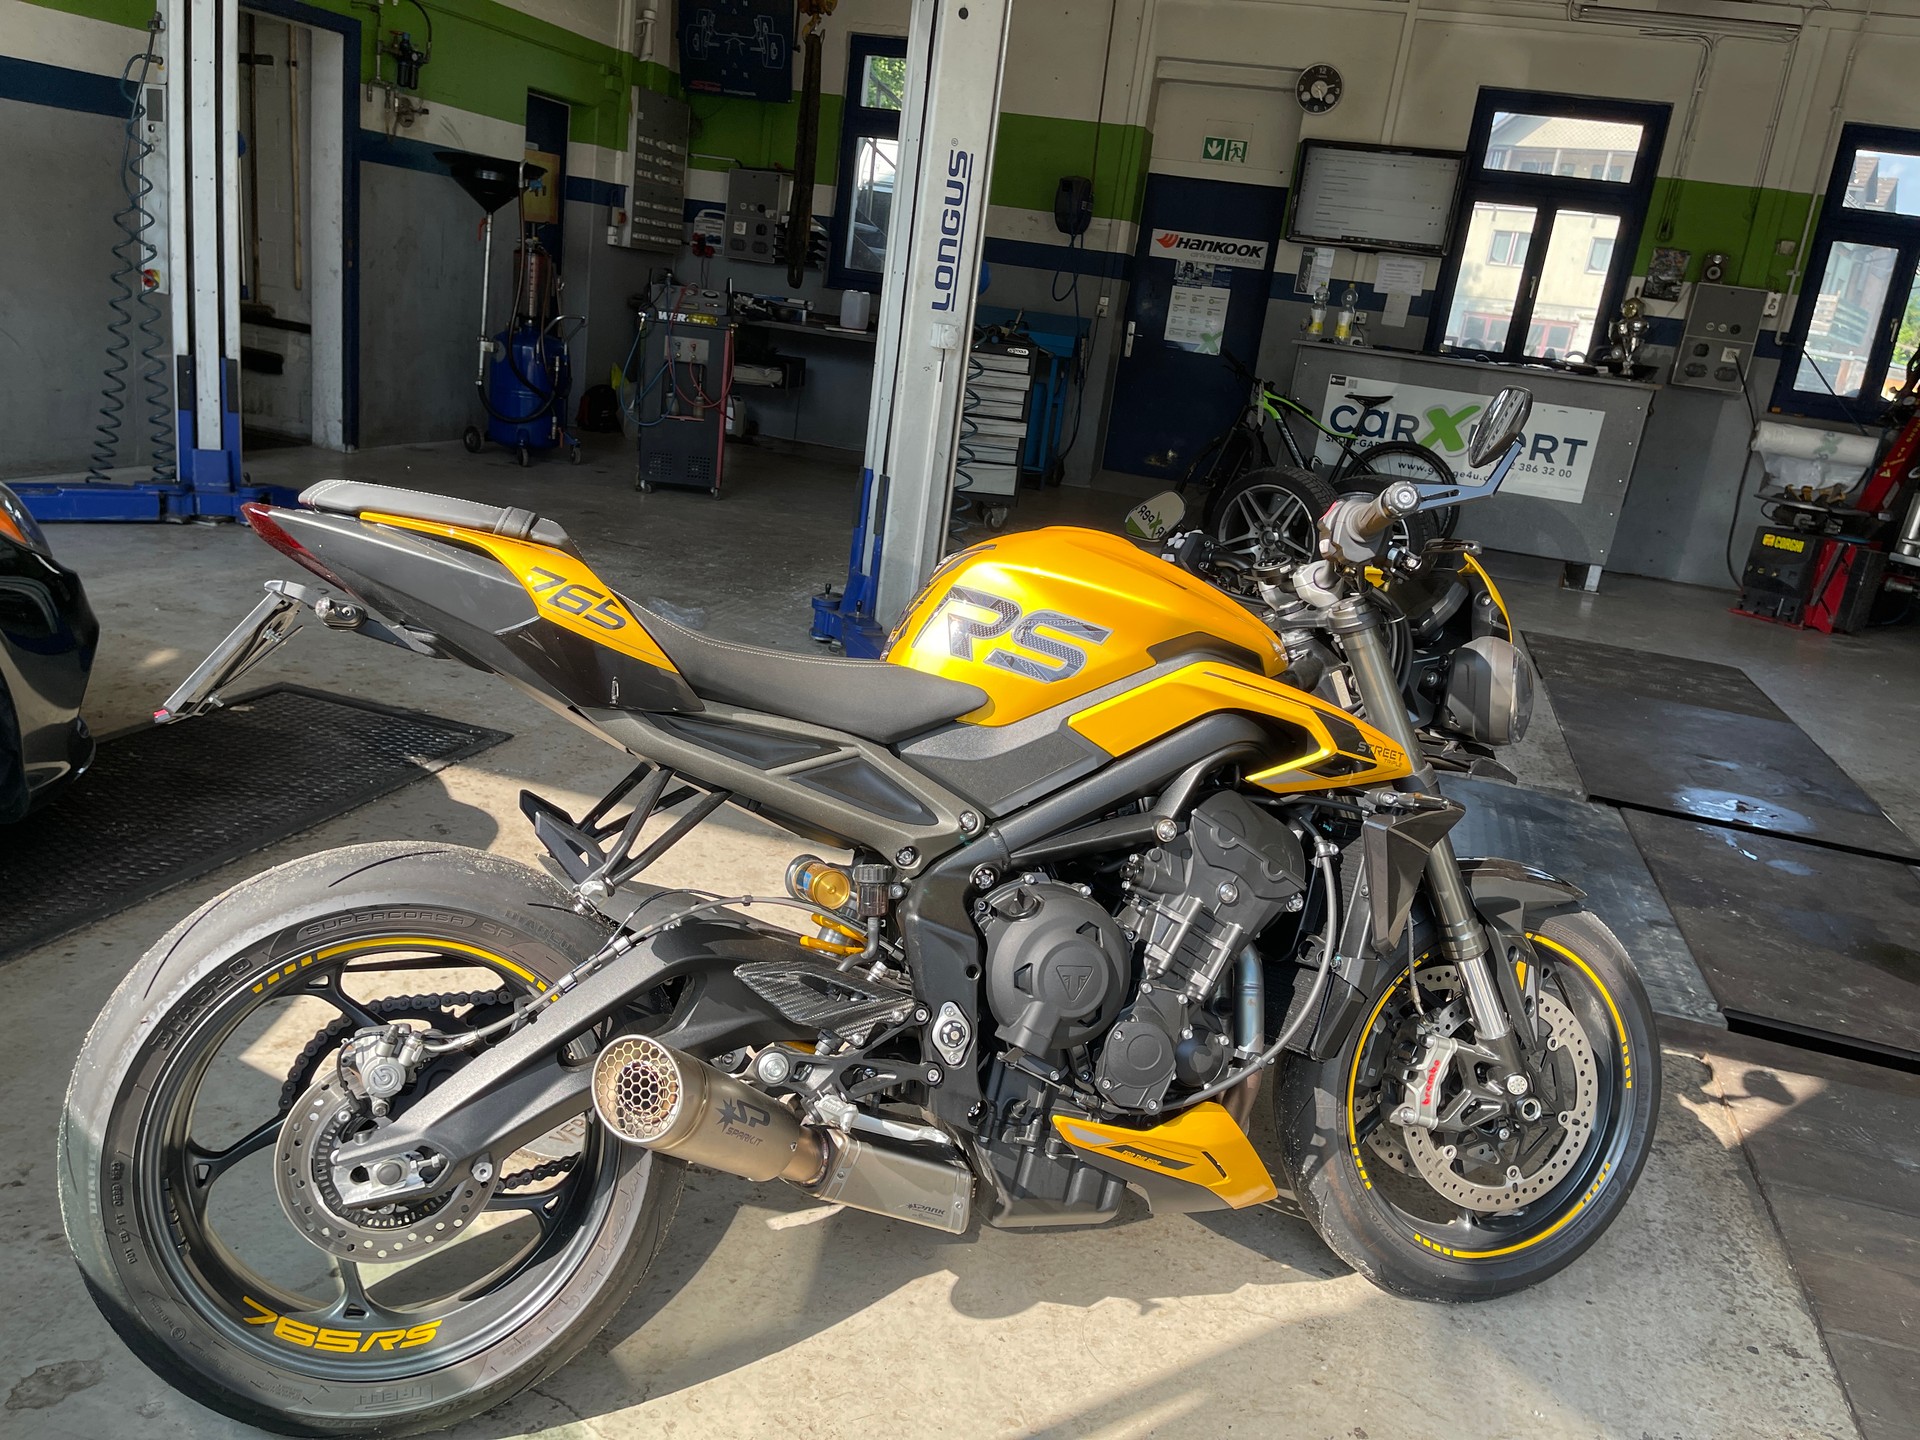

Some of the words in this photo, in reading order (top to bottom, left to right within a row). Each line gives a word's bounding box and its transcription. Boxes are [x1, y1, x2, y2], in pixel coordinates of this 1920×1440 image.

[931, 149, 968, 311] LONGUS
[1190, 251, 1220, 261] driving
[1222, 256, 1261, 265] emotion
[1518, 462, 1538, 473] 386
[1542, 466, 1555, 476] 32
[1558, 469, 1573, 479] 00
[1774, 536, 1805, 553] CORGHI
[530, 566, 627, 630] 765
[911, 584, 1115, 684] RS
[1357, 741, 1405, 761] STREET
[306, 911, 465, 936] SUPERCORSA
[480, 921, 515, 939] SP
[150, 956, 253, 1050] DIABLO
[1422, 1059, 1441, 1105] brembo
[242, 1295, 443, 1353] 765RS
